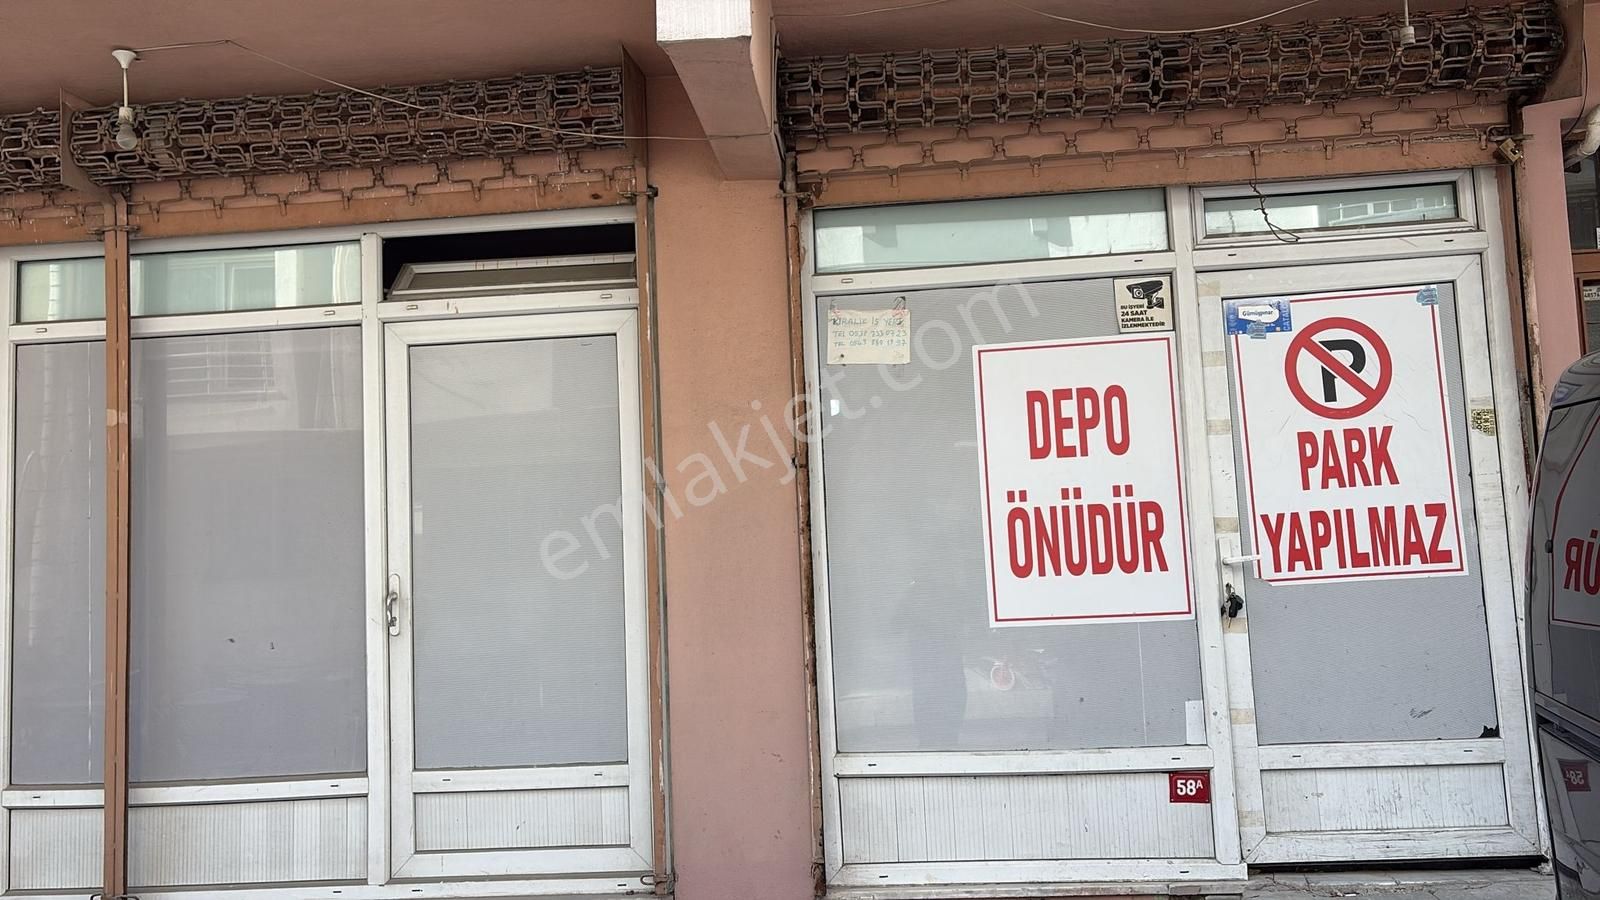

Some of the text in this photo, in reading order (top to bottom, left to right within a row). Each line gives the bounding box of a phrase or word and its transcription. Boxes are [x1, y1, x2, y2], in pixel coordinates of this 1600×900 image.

[1026, 384, 1131, 460] DEPO
[1297, 425, 1400, 491] PARK
[1006, 484, 1169, 579] ÖNÜDÜR
[1259, 502, 1454, 574] YAPILMAZ
